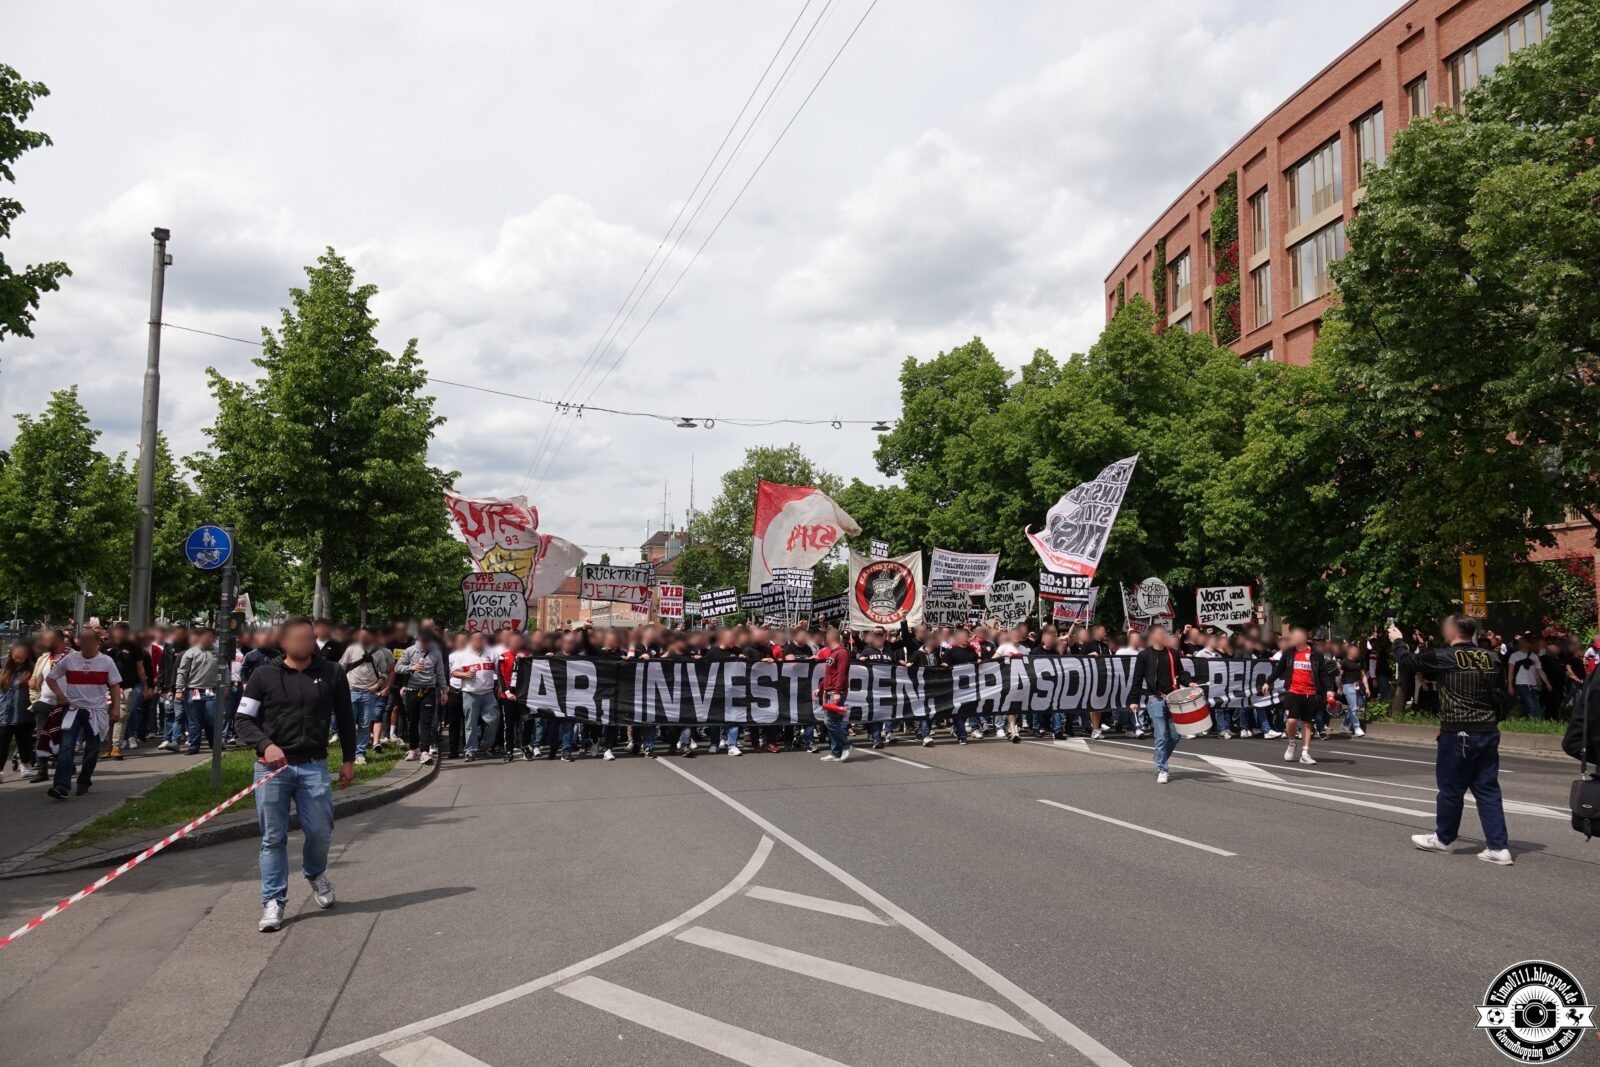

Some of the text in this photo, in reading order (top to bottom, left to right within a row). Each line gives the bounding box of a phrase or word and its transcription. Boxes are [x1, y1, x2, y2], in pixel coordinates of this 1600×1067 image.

[1470, 560, 1476, 568] U
[463, 581, 520, 591] STUTTGART
[788, 580, 812, 588] MAUL
[991, 582, 1026, 593] VOGT UND
[1071, 576, 1088, 588] IST
[584, 583, 648, 600] JETZT!
[661, 586, 682, 597] VfB
[713, 589, 734, 598] MACHT
[1200, 589, 1244, 602] VOGT und
[472, 594, 518, 607] VOGT &
[714, 597, 736, 605] VEREIN
[989, 592, 1014, 603] ADRION
[631, 604, 648, 614] WIR
[660, 606, 682, 616] WIR
[703, 604, 736, 616] KAPUTT
[990, 601, 1026, 613] ZEIT ZU
[1200, 602, 1232, 613] ADRION
[924, 611, 944, 623] VOGT
[1200, 614, 1218, 623] ZEIT
